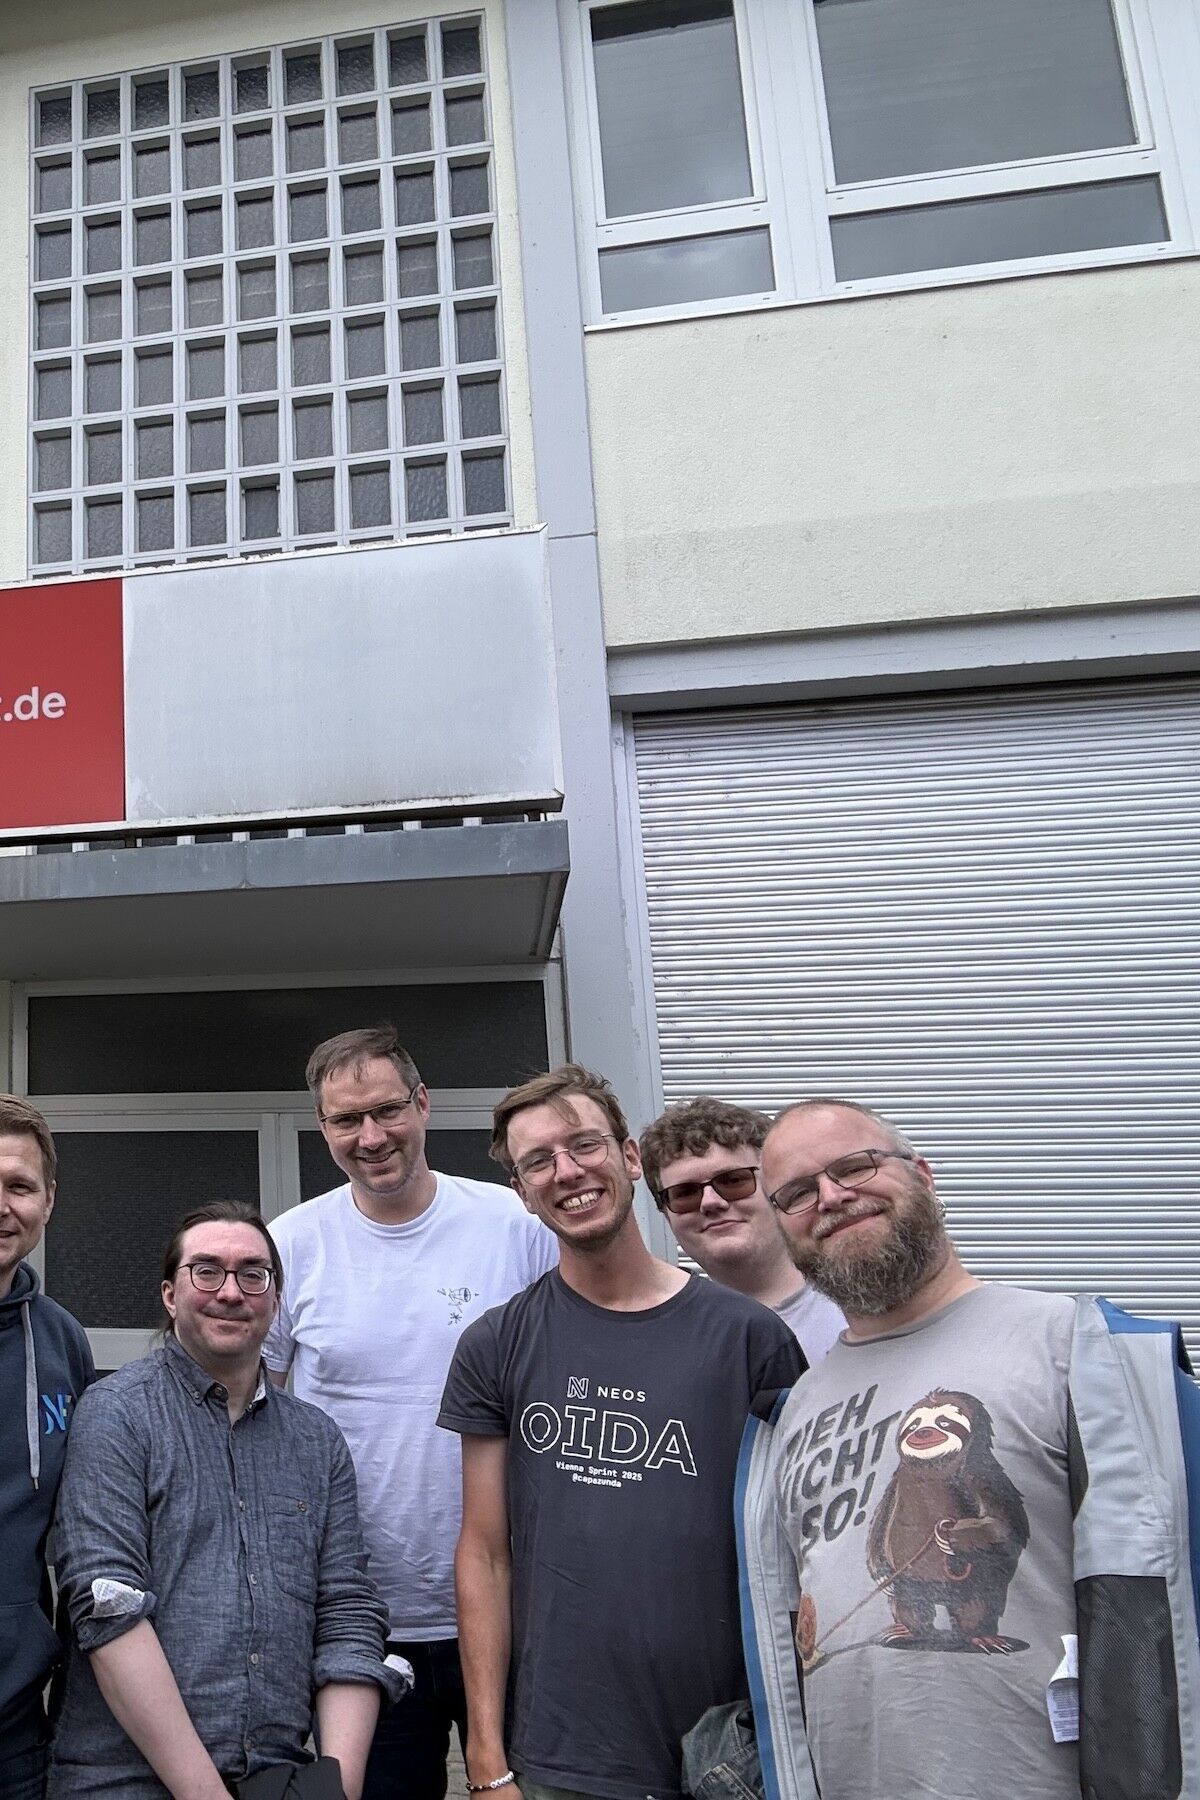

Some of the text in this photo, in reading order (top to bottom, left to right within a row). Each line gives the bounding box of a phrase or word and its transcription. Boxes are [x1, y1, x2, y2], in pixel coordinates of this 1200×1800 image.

[597, 1386, 647, 1403] NEOS
[520, 1402, 698, 1477] OIDA
[555, 1461, 643, 1482] Vienna Sprint 2025
[572, 1473, 622, 1488] @capazunda
[801, 1471, 877, 1561] SO!
